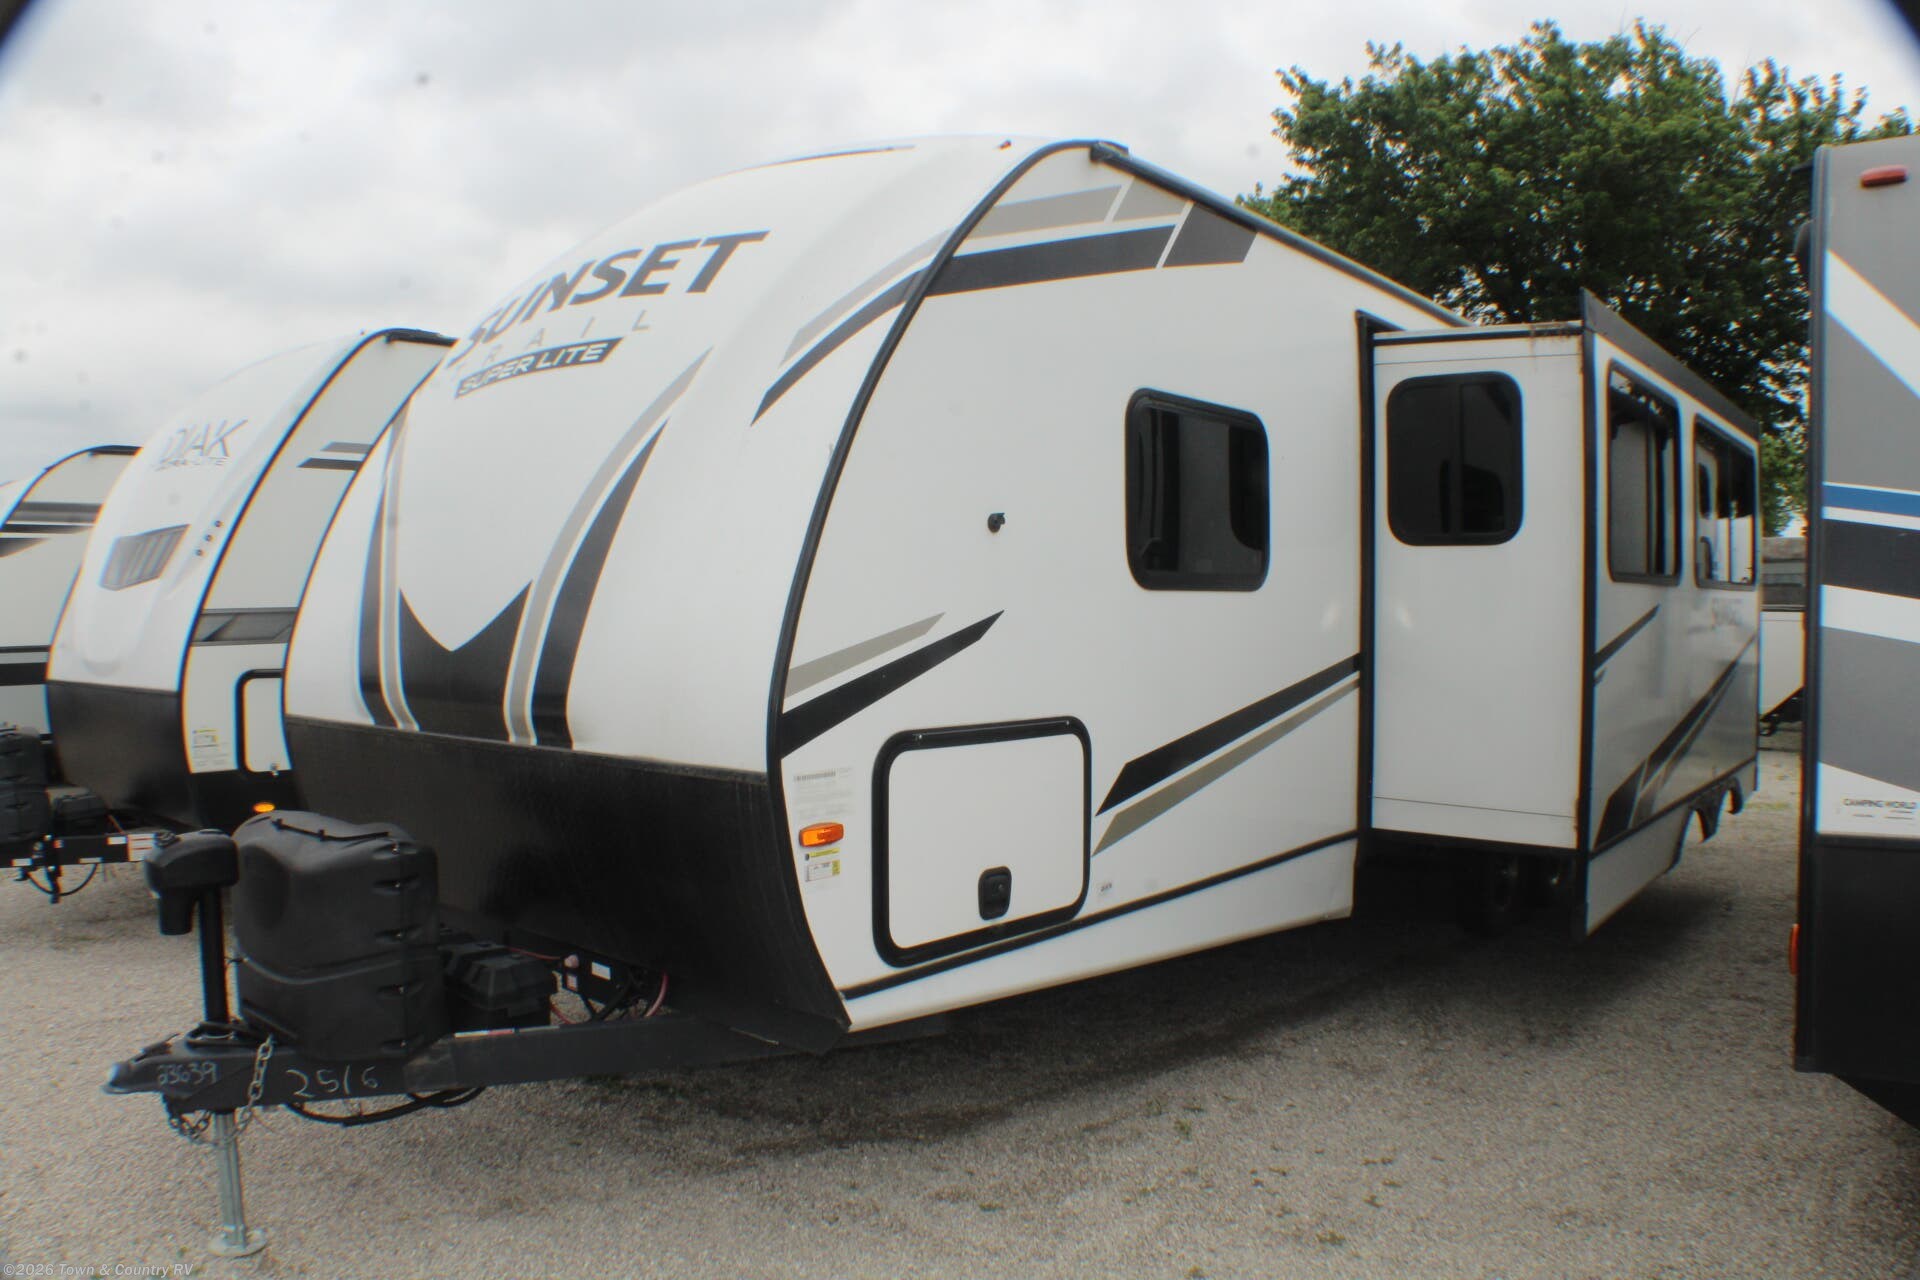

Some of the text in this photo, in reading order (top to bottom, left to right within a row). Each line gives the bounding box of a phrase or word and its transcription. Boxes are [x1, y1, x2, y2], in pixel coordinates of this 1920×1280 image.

[446, 230, 770, 369] SUNSET
[457, 343, 609, 395] SUPER LITE
[286, 1064, 378, 1098] 2516
